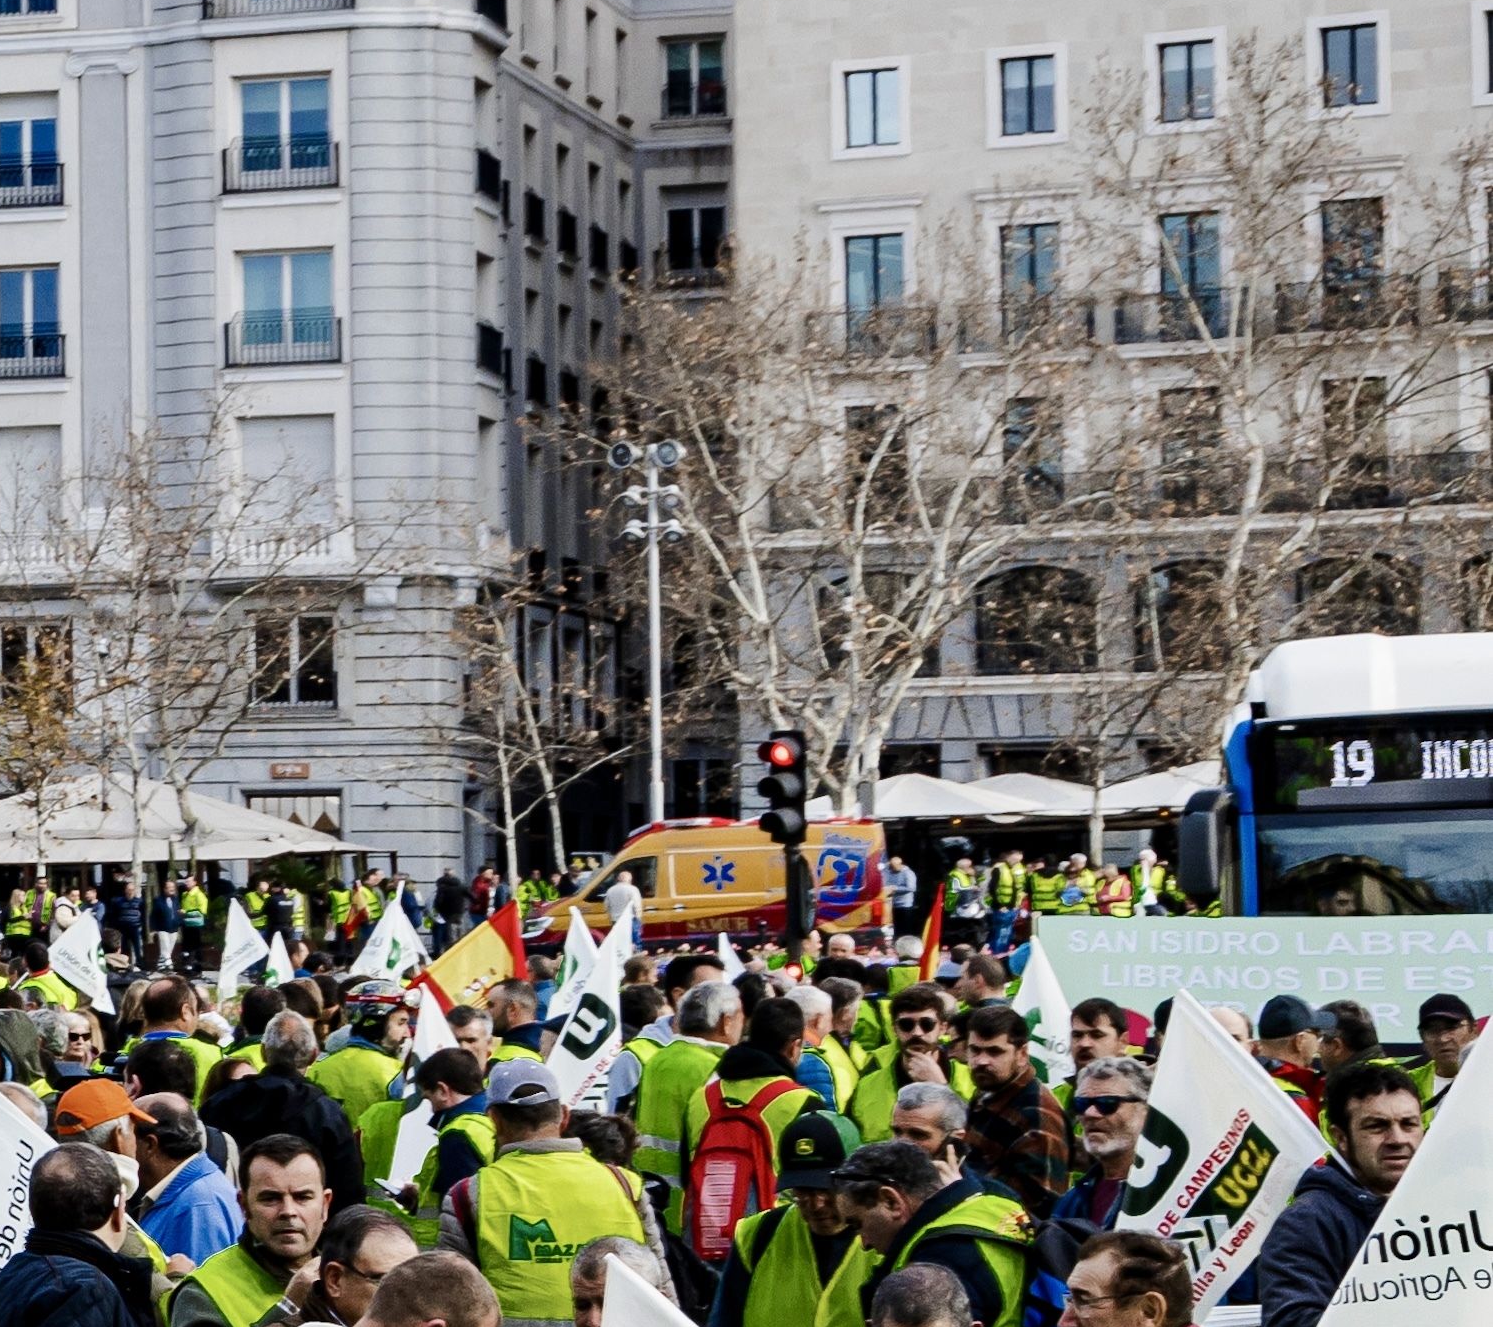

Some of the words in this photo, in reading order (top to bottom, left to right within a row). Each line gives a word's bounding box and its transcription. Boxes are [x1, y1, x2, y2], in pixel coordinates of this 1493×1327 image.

[1329, 739, 1375, 787] 19
[1068, 928, 1138, 955] SAN
[1150, 928, 1280, 956] ISIDRO
[1295, 928, 1493, 957] LABRA
[1101, 962, 1303, 991] LIBRANOS
[1318, 966, 1386, 992] DE
[570, 1074, 598, 1107] UNION
[595, 1057, 610, 1073] DE
[1156, 1209, 1182, 1238] DE
[1175, 1107, 1252, 1211] CAMPESINOS
[1212, 1256, 1227, 1272] y
